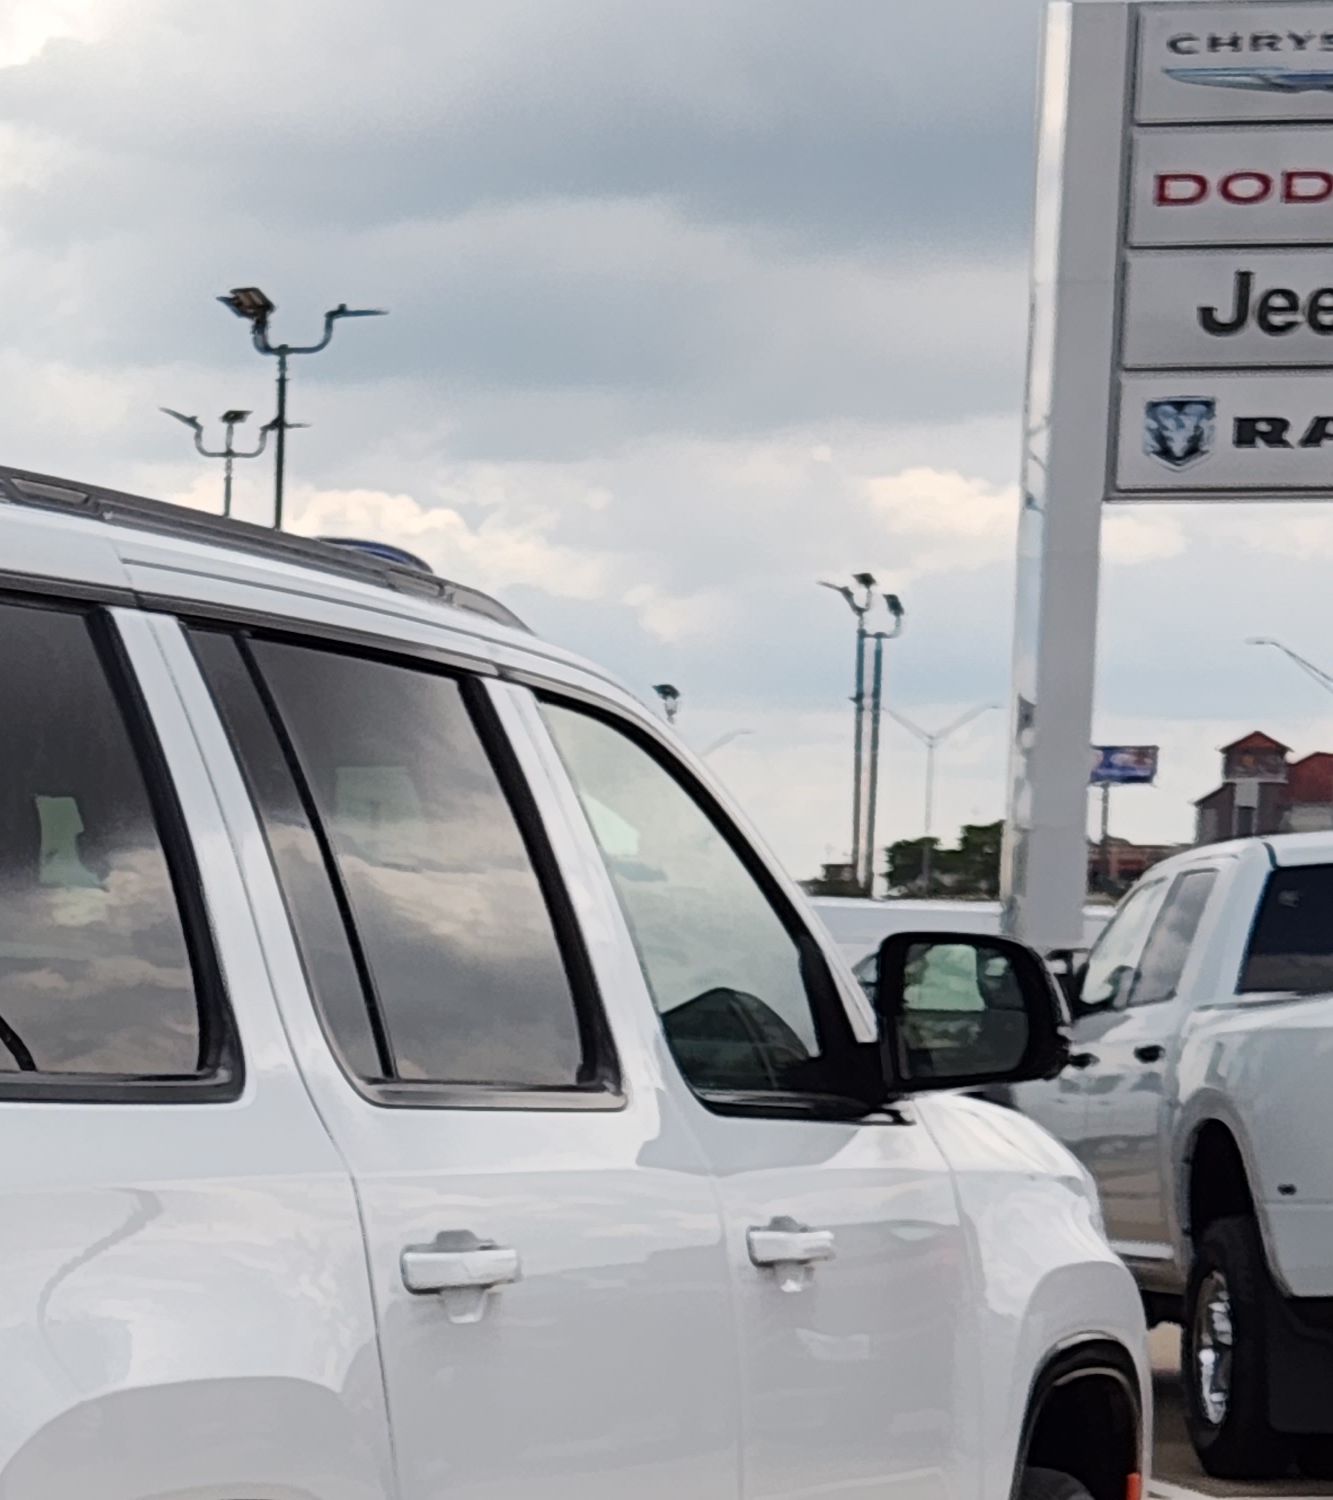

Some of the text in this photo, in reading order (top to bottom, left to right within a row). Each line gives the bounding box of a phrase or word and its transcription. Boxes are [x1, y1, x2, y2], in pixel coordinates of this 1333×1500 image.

[1153, 171, 1333, 207] DOD
[1197, 270, 1333, 337] Jee
[1233, 416, 1333, 448] RA
